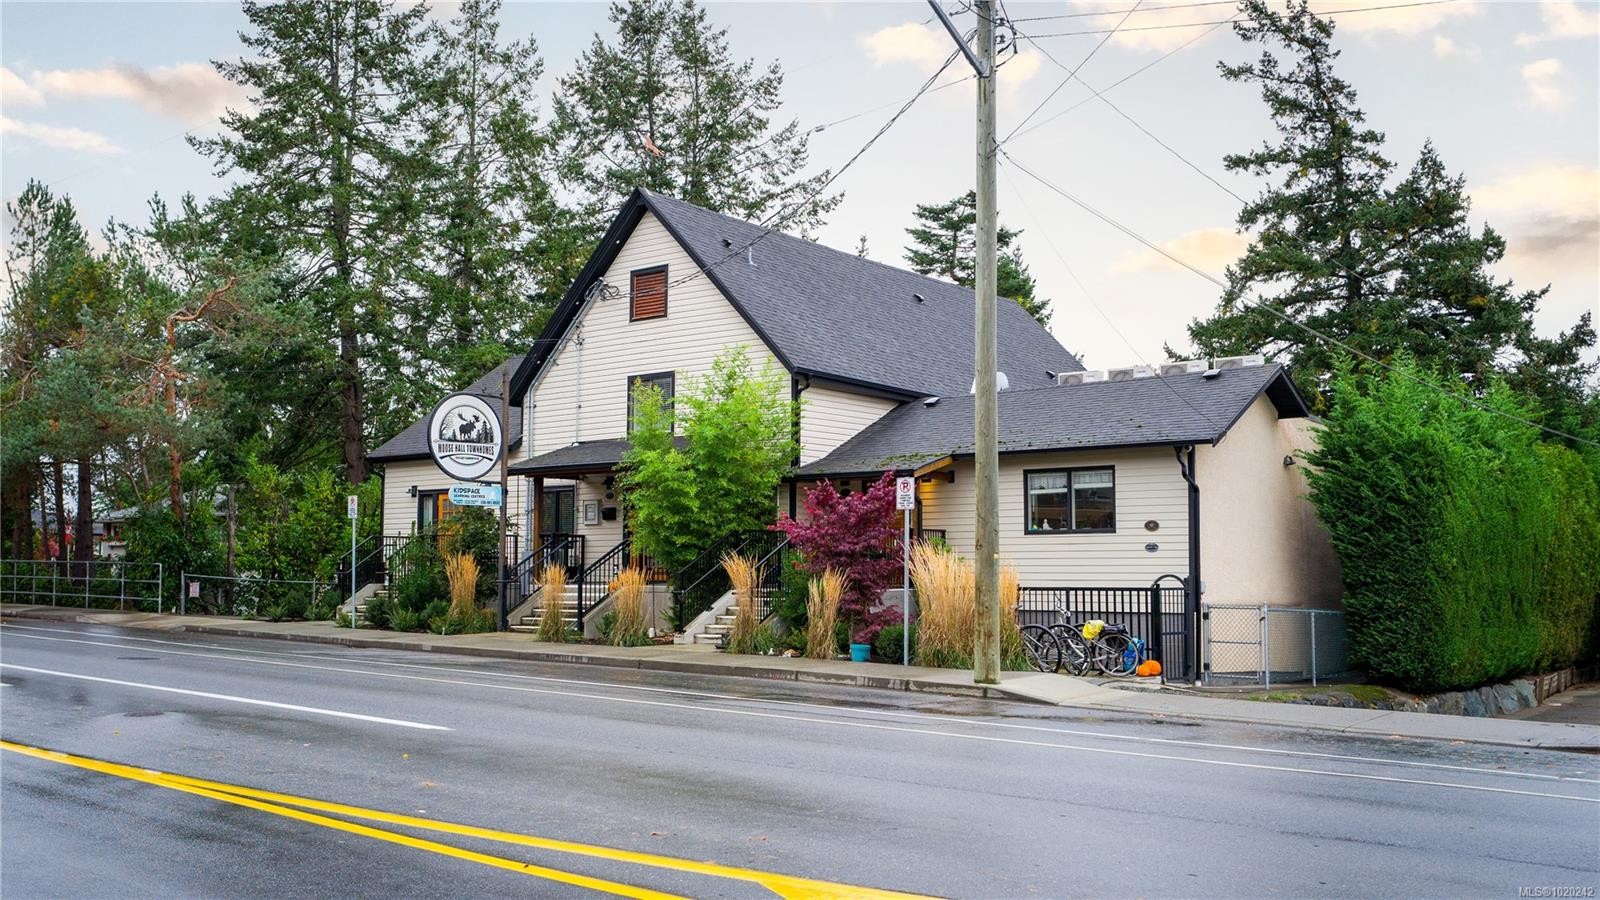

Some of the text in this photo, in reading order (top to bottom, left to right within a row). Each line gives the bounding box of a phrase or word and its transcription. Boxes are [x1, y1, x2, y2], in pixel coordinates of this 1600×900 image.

[438, 443, 495, 456] MOOSE HALL TOWNHOMES
